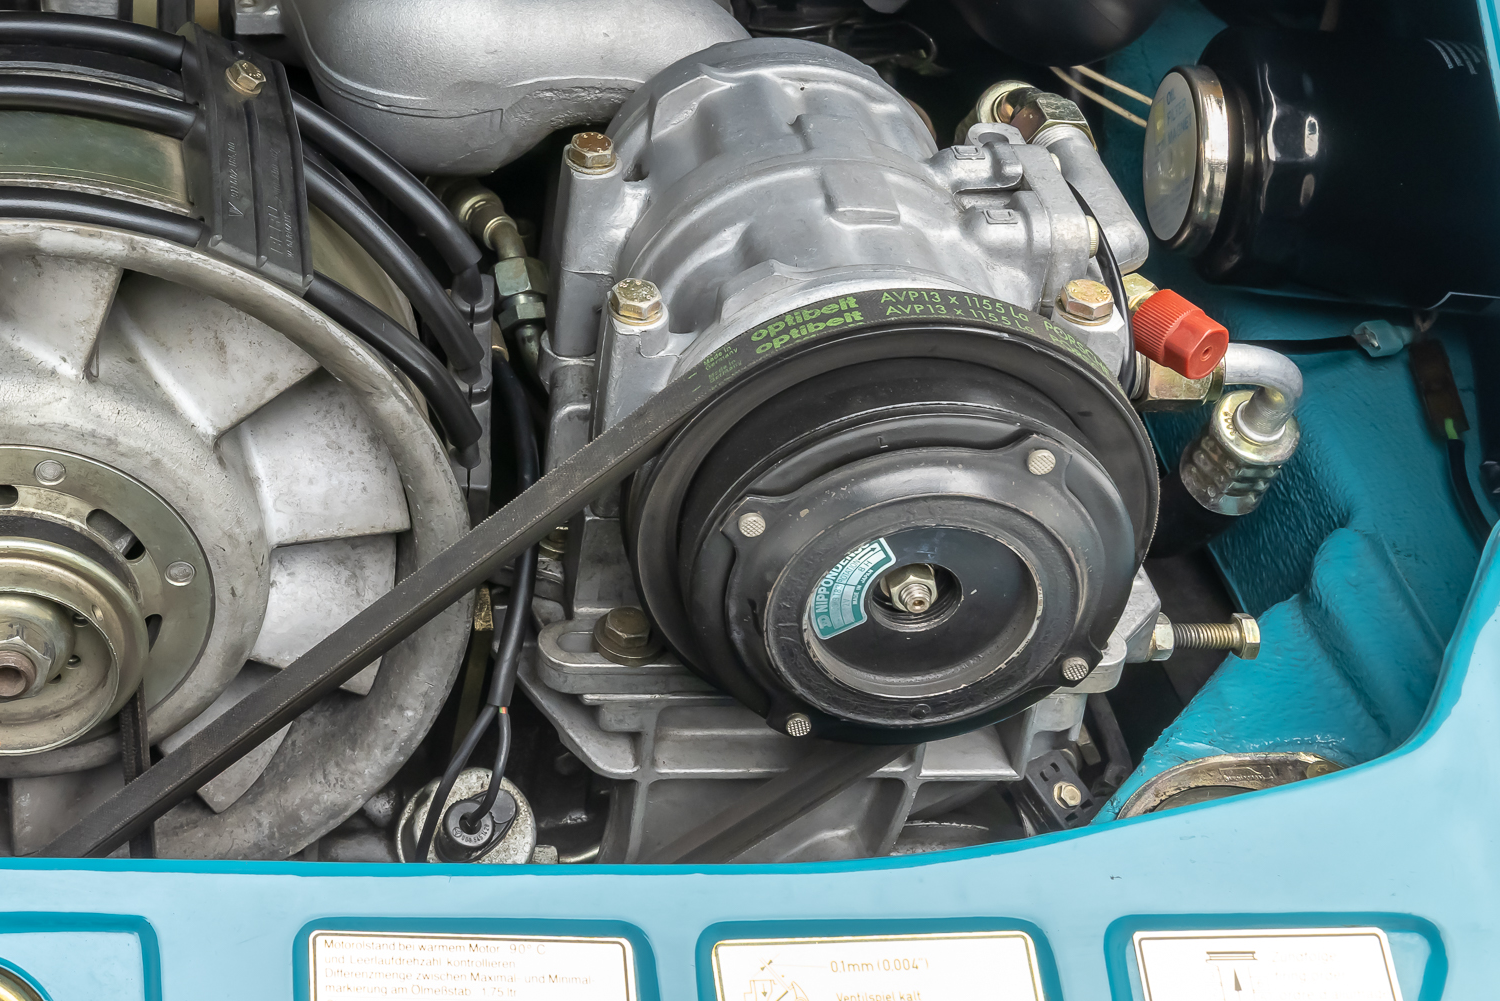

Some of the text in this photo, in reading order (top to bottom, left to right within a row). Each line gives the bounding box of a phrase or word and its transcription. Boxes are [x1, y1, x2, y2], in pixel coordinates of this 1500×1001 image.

[880, 291, 941, 304] AVP13
[885, 304, 947, 317] AVP13
[751, 296, 859, 342] optibelt
[756, 310, 864, 354] optibelt
[398, 941, 416, 952] bei
[417, 943, 466, 954] warmem
[468, 943, 500, 954] Motor
[536, 944, 546, 955] C
[324, 953, 516, 969] und Leerlaufdrehzahl kontrollieren
[324, 967, 413, 982] Differenzmenge
[416, 970, 467, 982] zwischen
[524, 974, 546, 984] und
[324, 982, 388, 997] markierung
[391, 985, 409, 995] am
